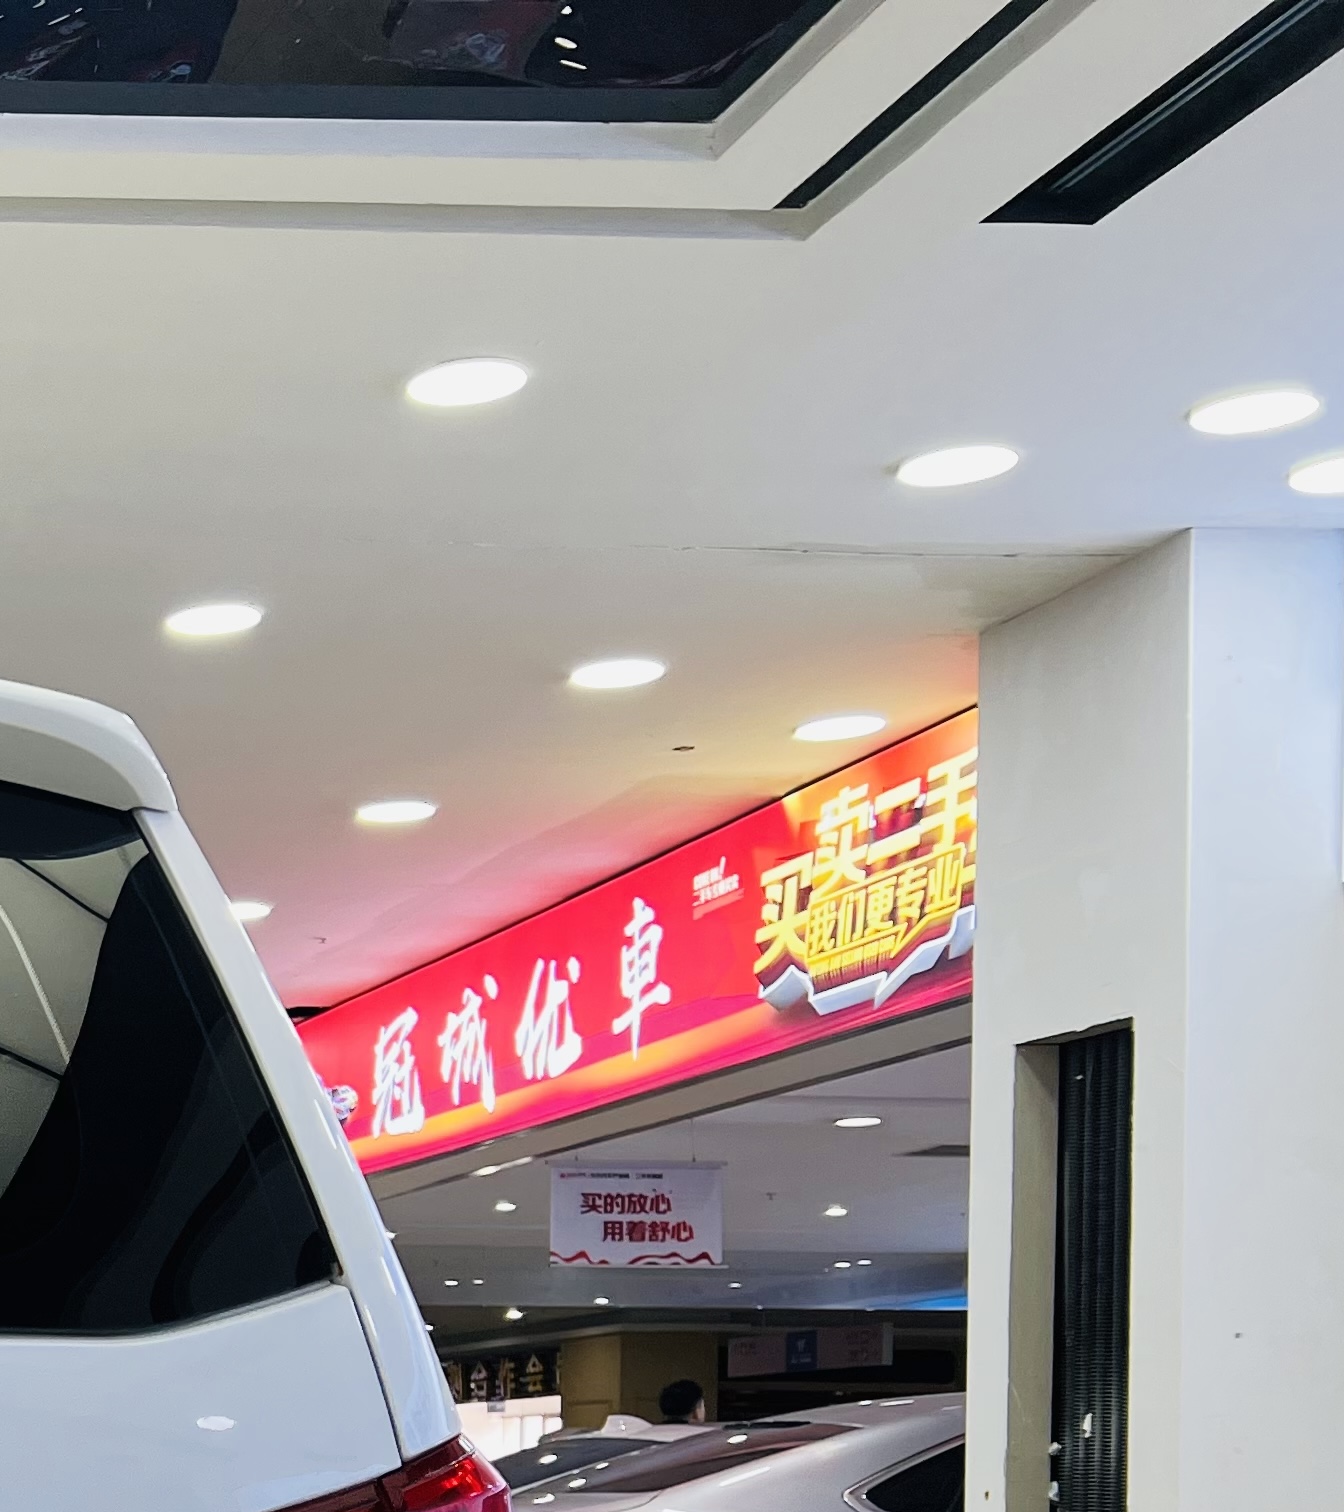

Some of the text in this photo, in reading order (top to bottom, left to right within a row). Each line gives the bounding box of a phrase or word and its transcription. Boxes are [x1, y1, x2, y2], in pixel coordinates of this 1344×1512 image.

[808, 852, 963, 957] 我们更专业
[580, 1192, 672, 1215] 买的放心
[602, 1220, 694, 1243] 用着舒心
